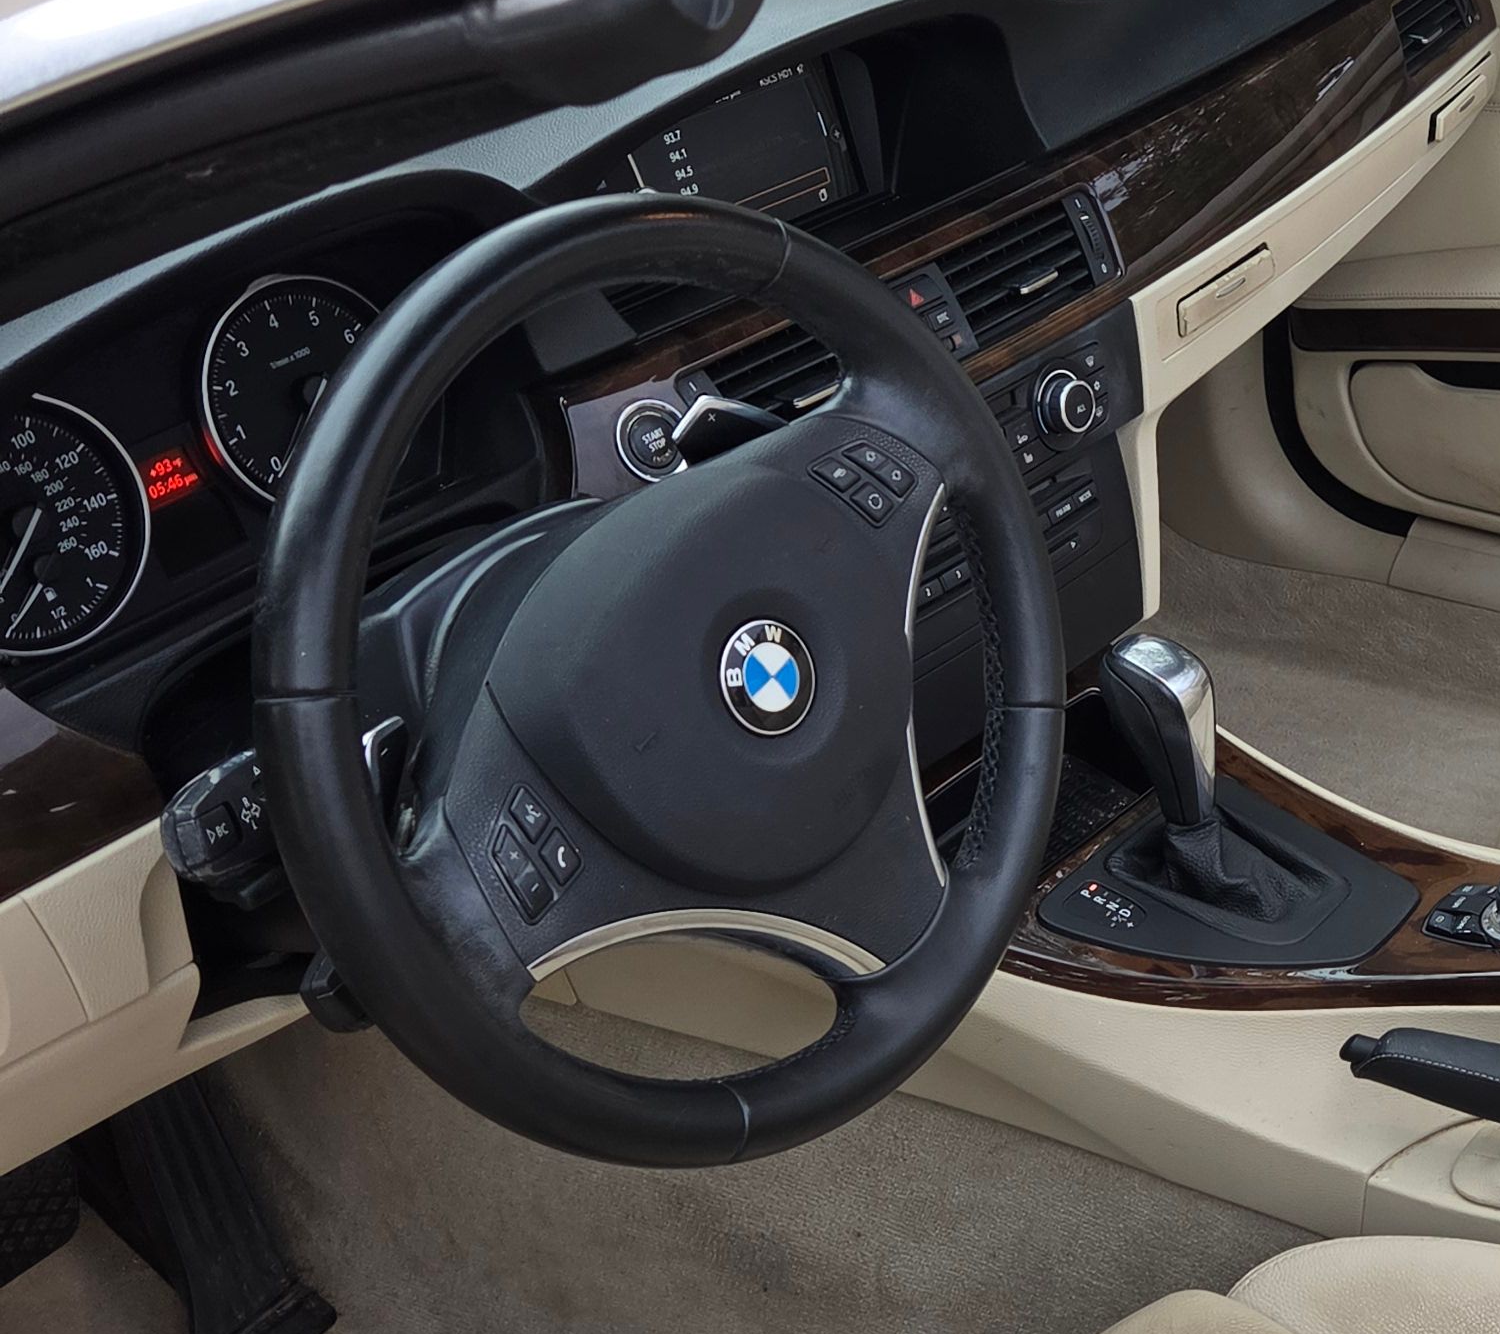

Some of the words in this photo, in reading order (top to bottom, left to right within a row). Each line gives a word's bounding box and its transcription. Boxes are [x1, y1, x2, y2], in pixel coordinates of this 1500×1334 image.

[663, 130, 681, 145] 93.7
[669, 148, 688, 163] 94.1
[675, 165, 694, 181] 94.5
[268, 314, 279, 329] 4
[308, 310, 320, 327] 5
[343, 329, 355, 344] 6
[236, 341, 250, 357] 3
[225, 380, 239, 397] 2
[11, 430, 36, 449] 100
[235, 424, 246, 440] 1
[641, 427, 665, 445] START
[648, 437, 667, 453] STOP
[14, 460, 33, 476] 160
[55, 450, 79, 470] 120
[270, 456, 282, 471] 0
[30, 468, 50, 483] 180
[44, 479, 64, 496] 200
[148, 473, 184, 499] 05:46
[55, 496, 75, 513] 220
[83, 492, 107, 512] 140
[60, 515, 79, 532] 240
[57, 536, 77, 553] 260
[84, 540, 108, 561] 160
[86, 577, 93, 587] 1
[51, 606, 67, 620] 1/2
[726, 624, 782, 687] BMW
[216, 822, 229, 838] BC
[1080, 889, 1091, 898] P
[1093, 895, 1107, 905] R
[1105, 901, 1120, 911] N
[1119, 908, 1131, 918] D
